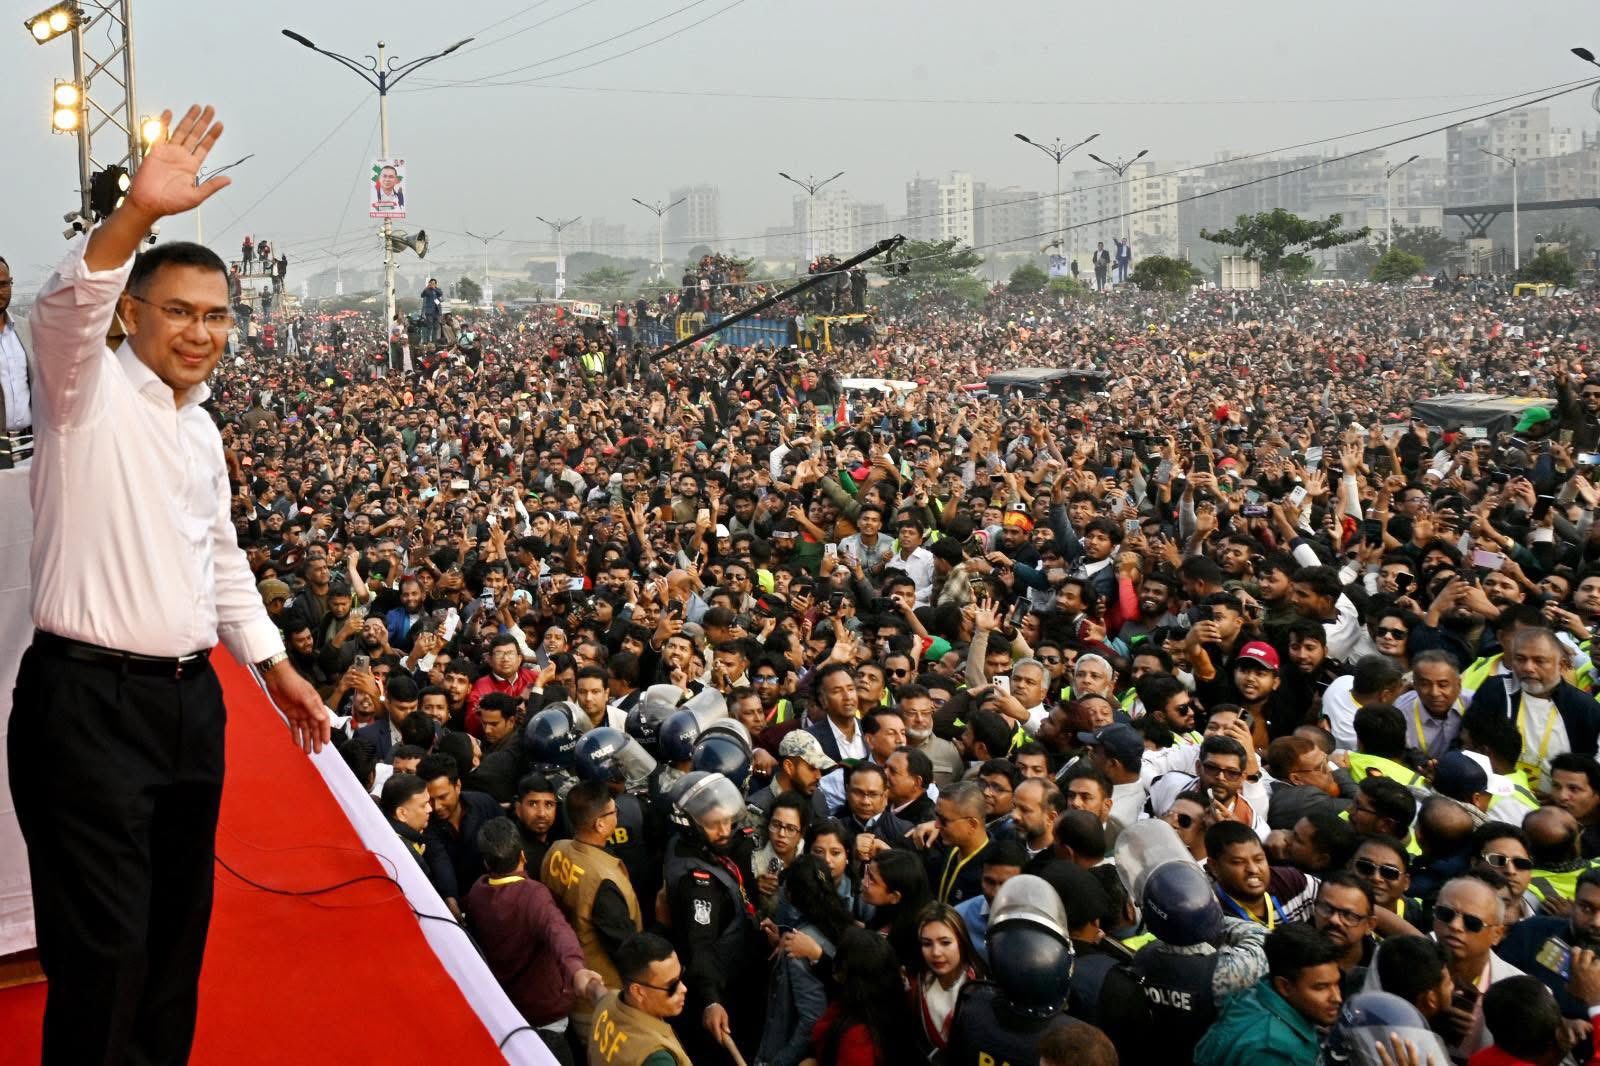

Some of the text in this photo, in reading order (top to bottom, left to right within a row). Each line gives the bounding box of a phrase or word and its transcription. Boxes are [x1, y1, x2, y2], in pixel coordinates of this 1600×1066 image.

[559, 740, 577, 753] POLIC
[591, 744, 615, 760] POLICE
[549, 850, 585, 889] CSF
[594, 1009, 628, 1063] CSF
